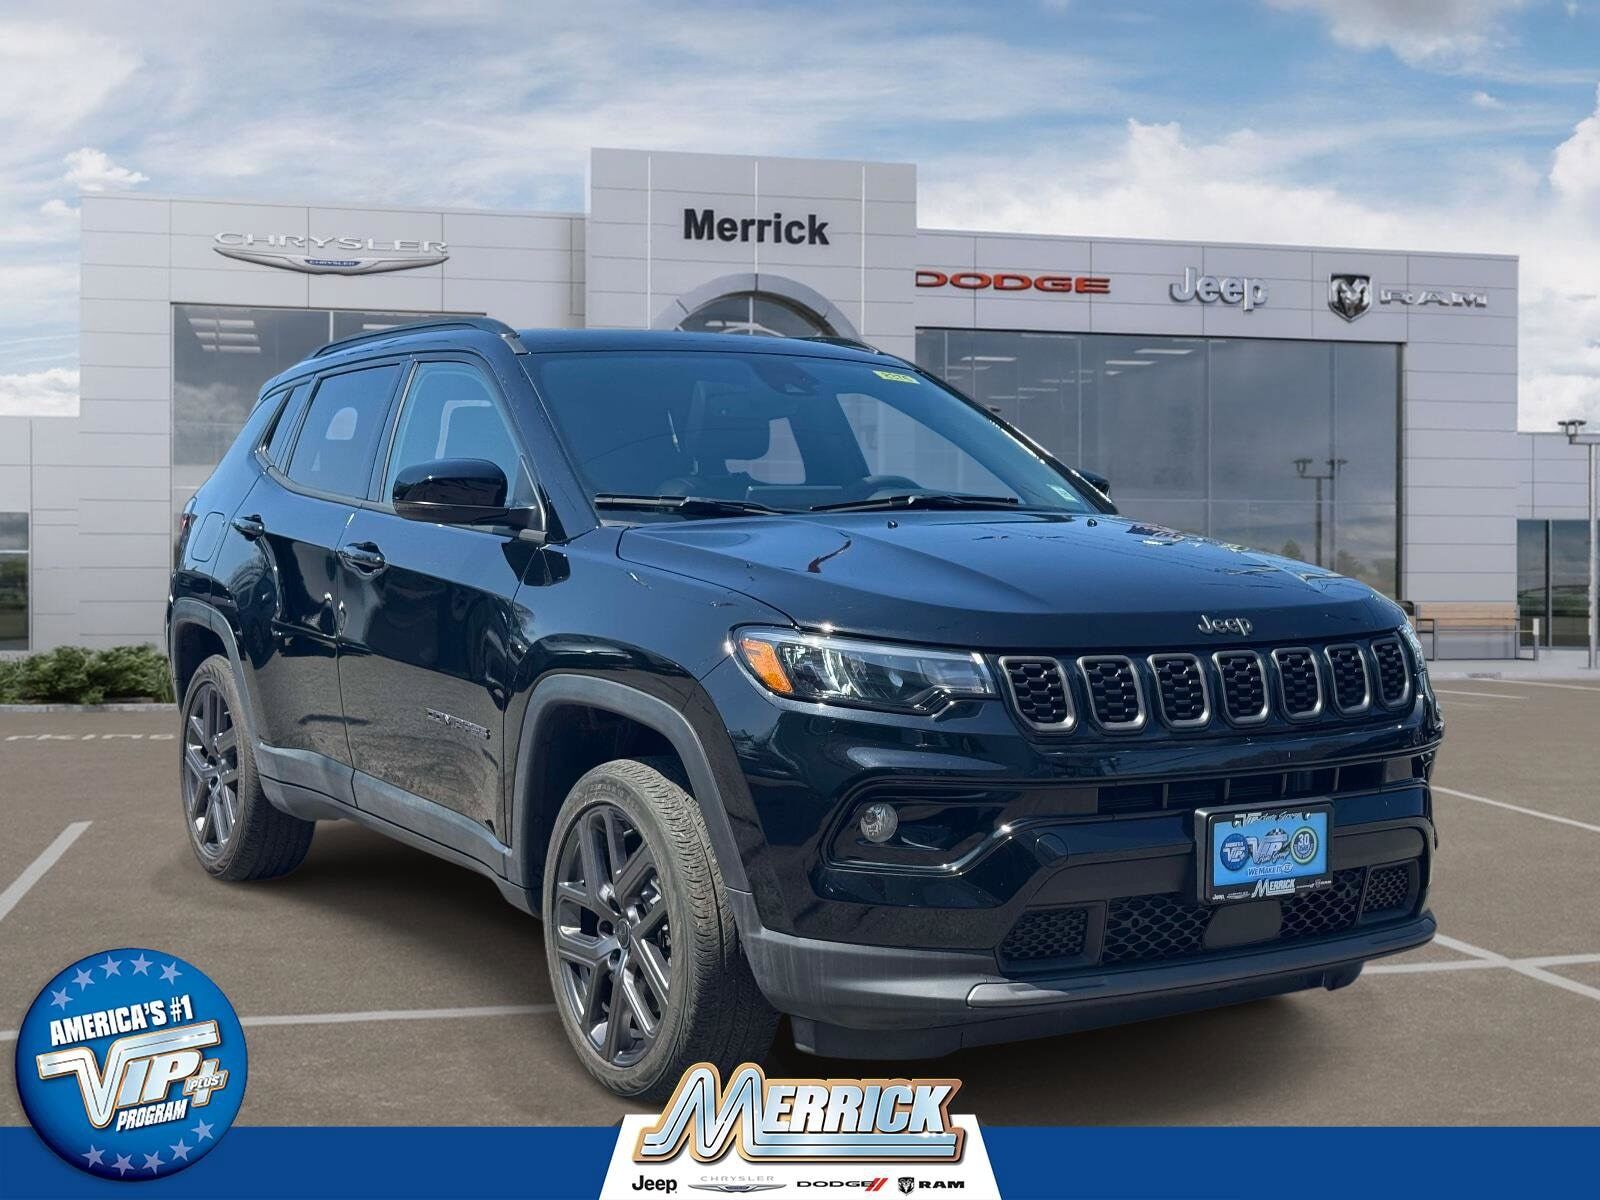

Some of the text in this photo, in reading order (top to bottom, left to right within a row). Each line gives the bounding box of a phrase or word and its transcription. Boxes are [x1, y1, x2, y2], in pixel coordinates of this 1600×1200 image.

[684, 208, 830, 245] Merrick
[215, 232, 449, 253] CHRYSLER
[915, 271, 1111, 294] DODGE
[1169, 266, 1268, 312] Jeep
[1379, 288, 1487, 307] RAM
[1197, 614, 1253, 636] Jeep
[1298, 834, 1310, 846] 30
[1251, 879, 1295, 898] MERRICK
